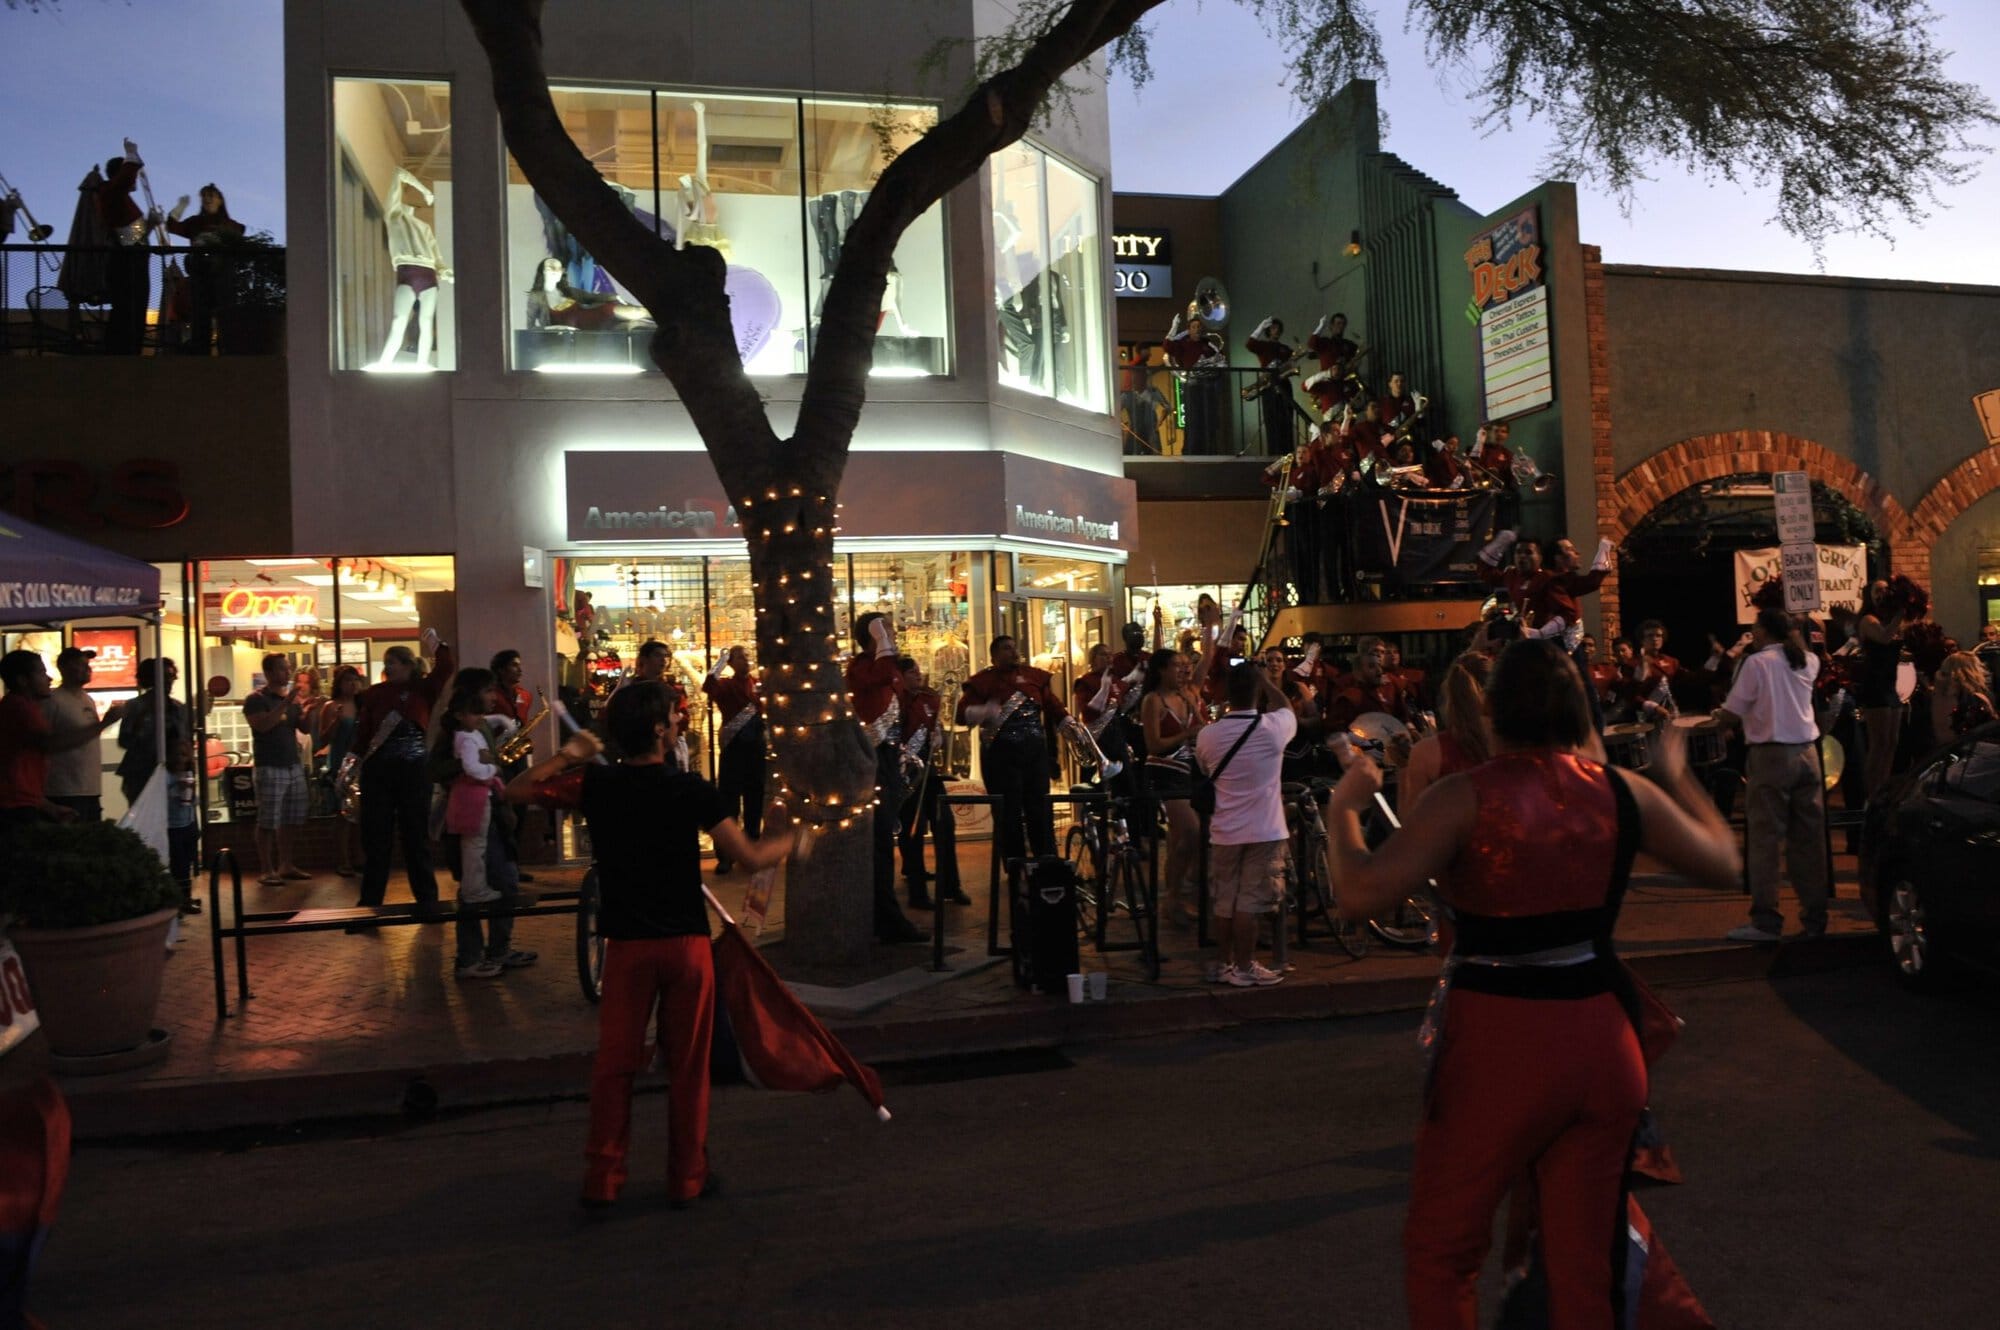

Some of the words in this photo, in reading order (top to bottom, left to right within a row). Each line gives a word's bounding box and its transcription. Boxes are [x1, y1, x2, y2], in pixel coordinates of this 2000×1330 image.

[1112, 234, 1162, 256] ITY
[1474, 244, 1542, 308] DECK
[584, 505, 716, 528] American
[1015, 504, 1075, 534] American
[1077, 515, 1119, 541] Apparel
[25, 583, 50, 608] OLD
[51, 583, 96, 608] SCHOOL
[221, 588, 314, 619] Open
[1790, 583, 1815, 602] ONLY
